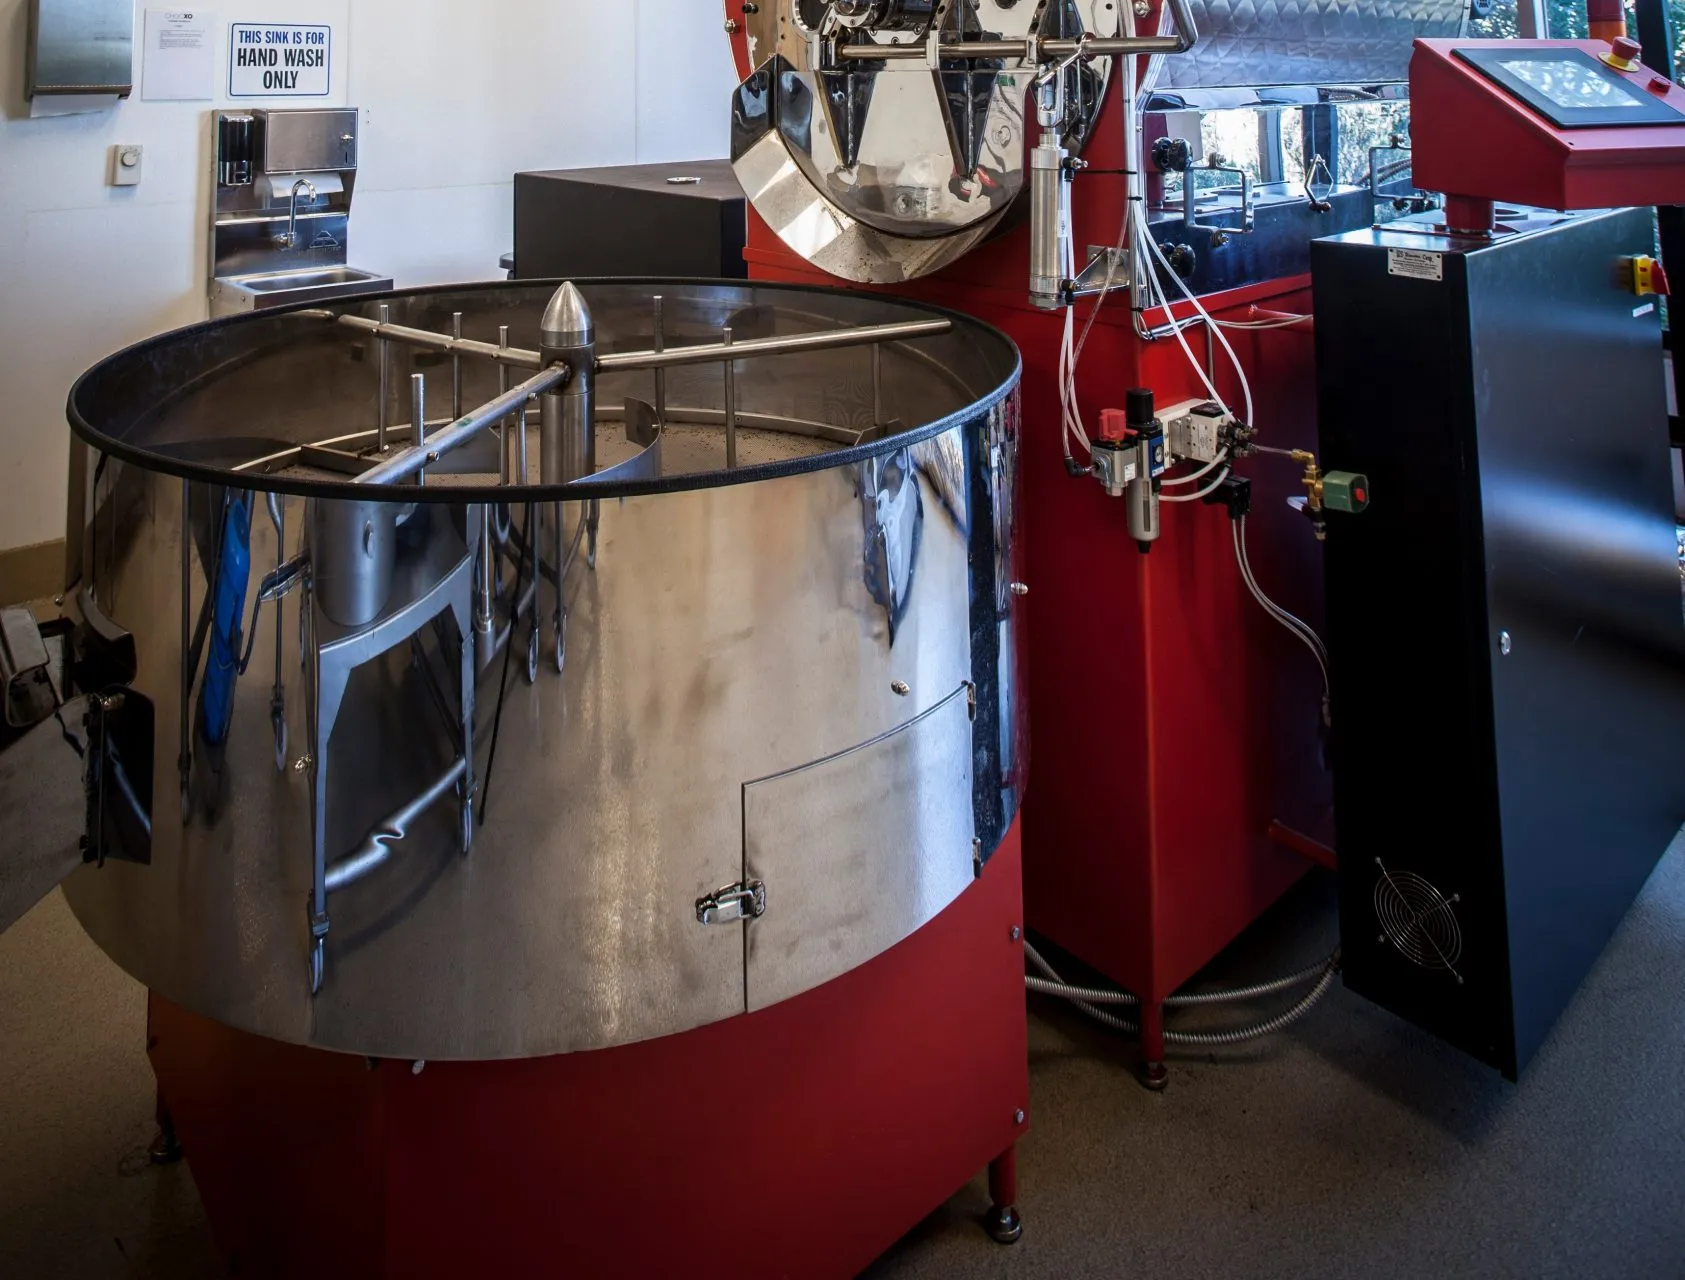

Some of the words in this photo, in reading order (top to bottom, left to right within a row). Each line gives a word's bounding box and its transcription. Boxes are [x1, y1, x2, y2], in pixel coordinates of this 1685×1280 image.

[239, 30, 262, 44] THIS
[265, 30, 289, 44] SINK
[293, 31, 302, 45] IS
[305, 31, 325, 45] FOR
[237, 47, 278, 67] HAND
[284, 48, 324, 67] WASH
[263, 70, 299, 89] ONLY
